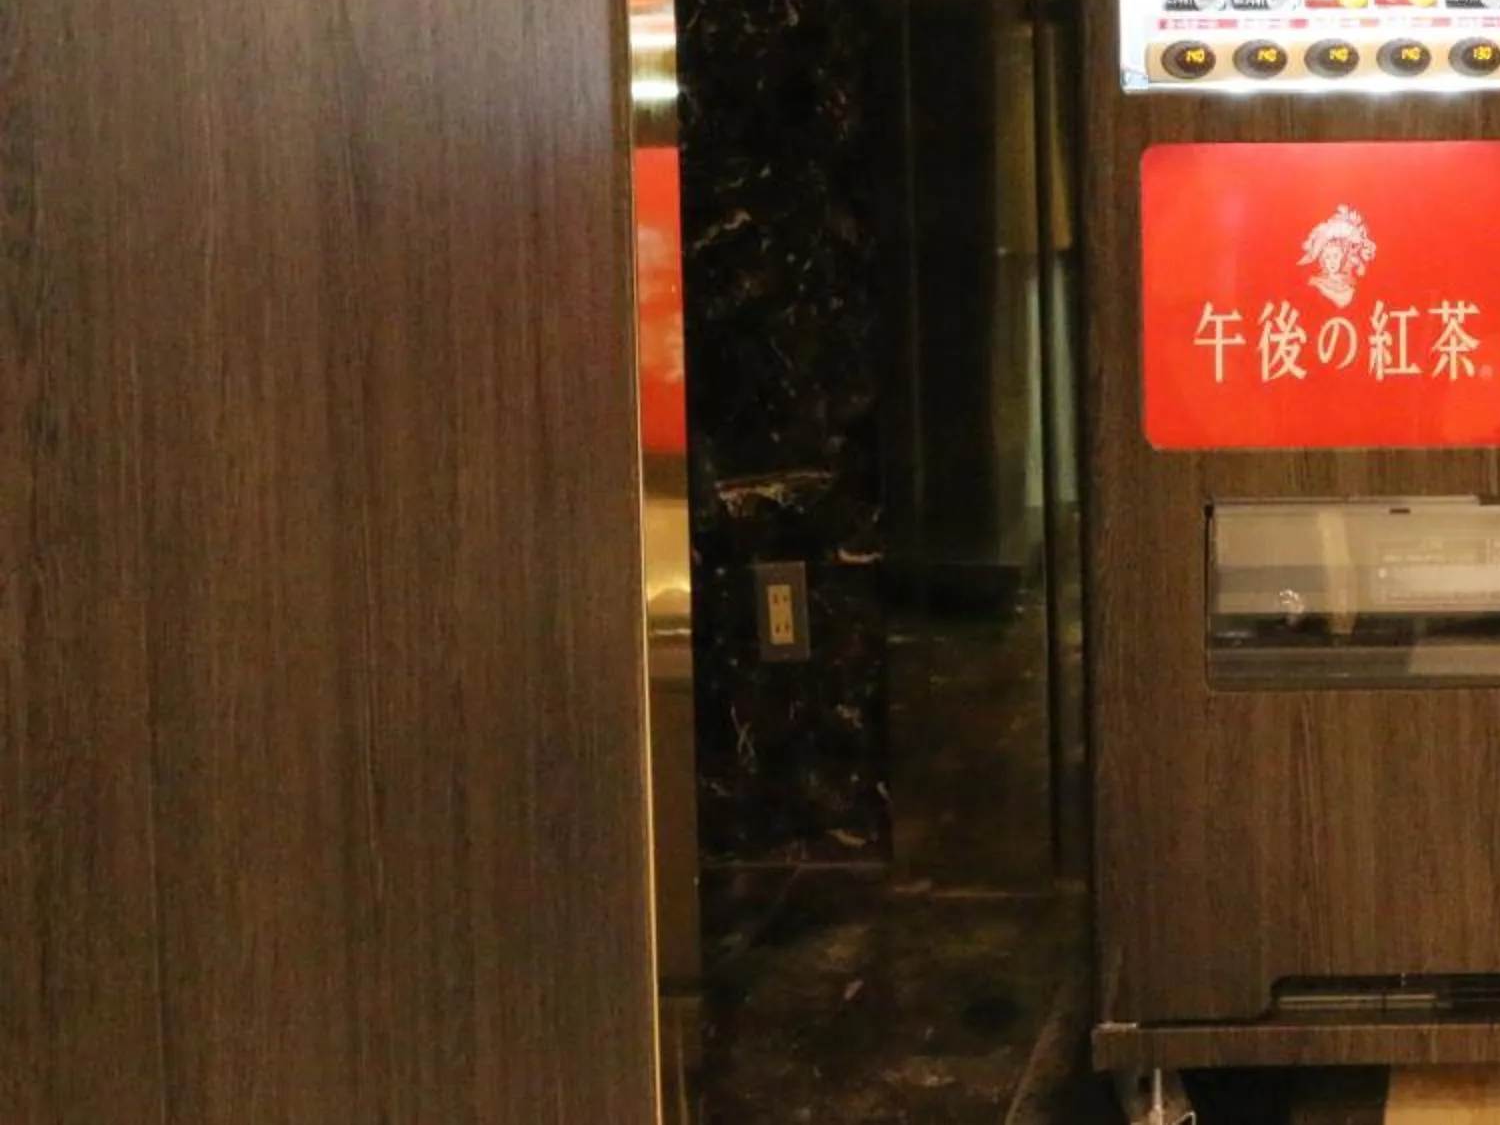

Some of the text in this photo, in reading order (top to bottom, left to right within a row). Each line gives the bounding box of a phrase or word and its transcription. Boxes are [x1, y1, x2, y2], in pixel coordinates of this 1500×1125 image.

[1193, 299, 1481, 383] 午後の紅茶
